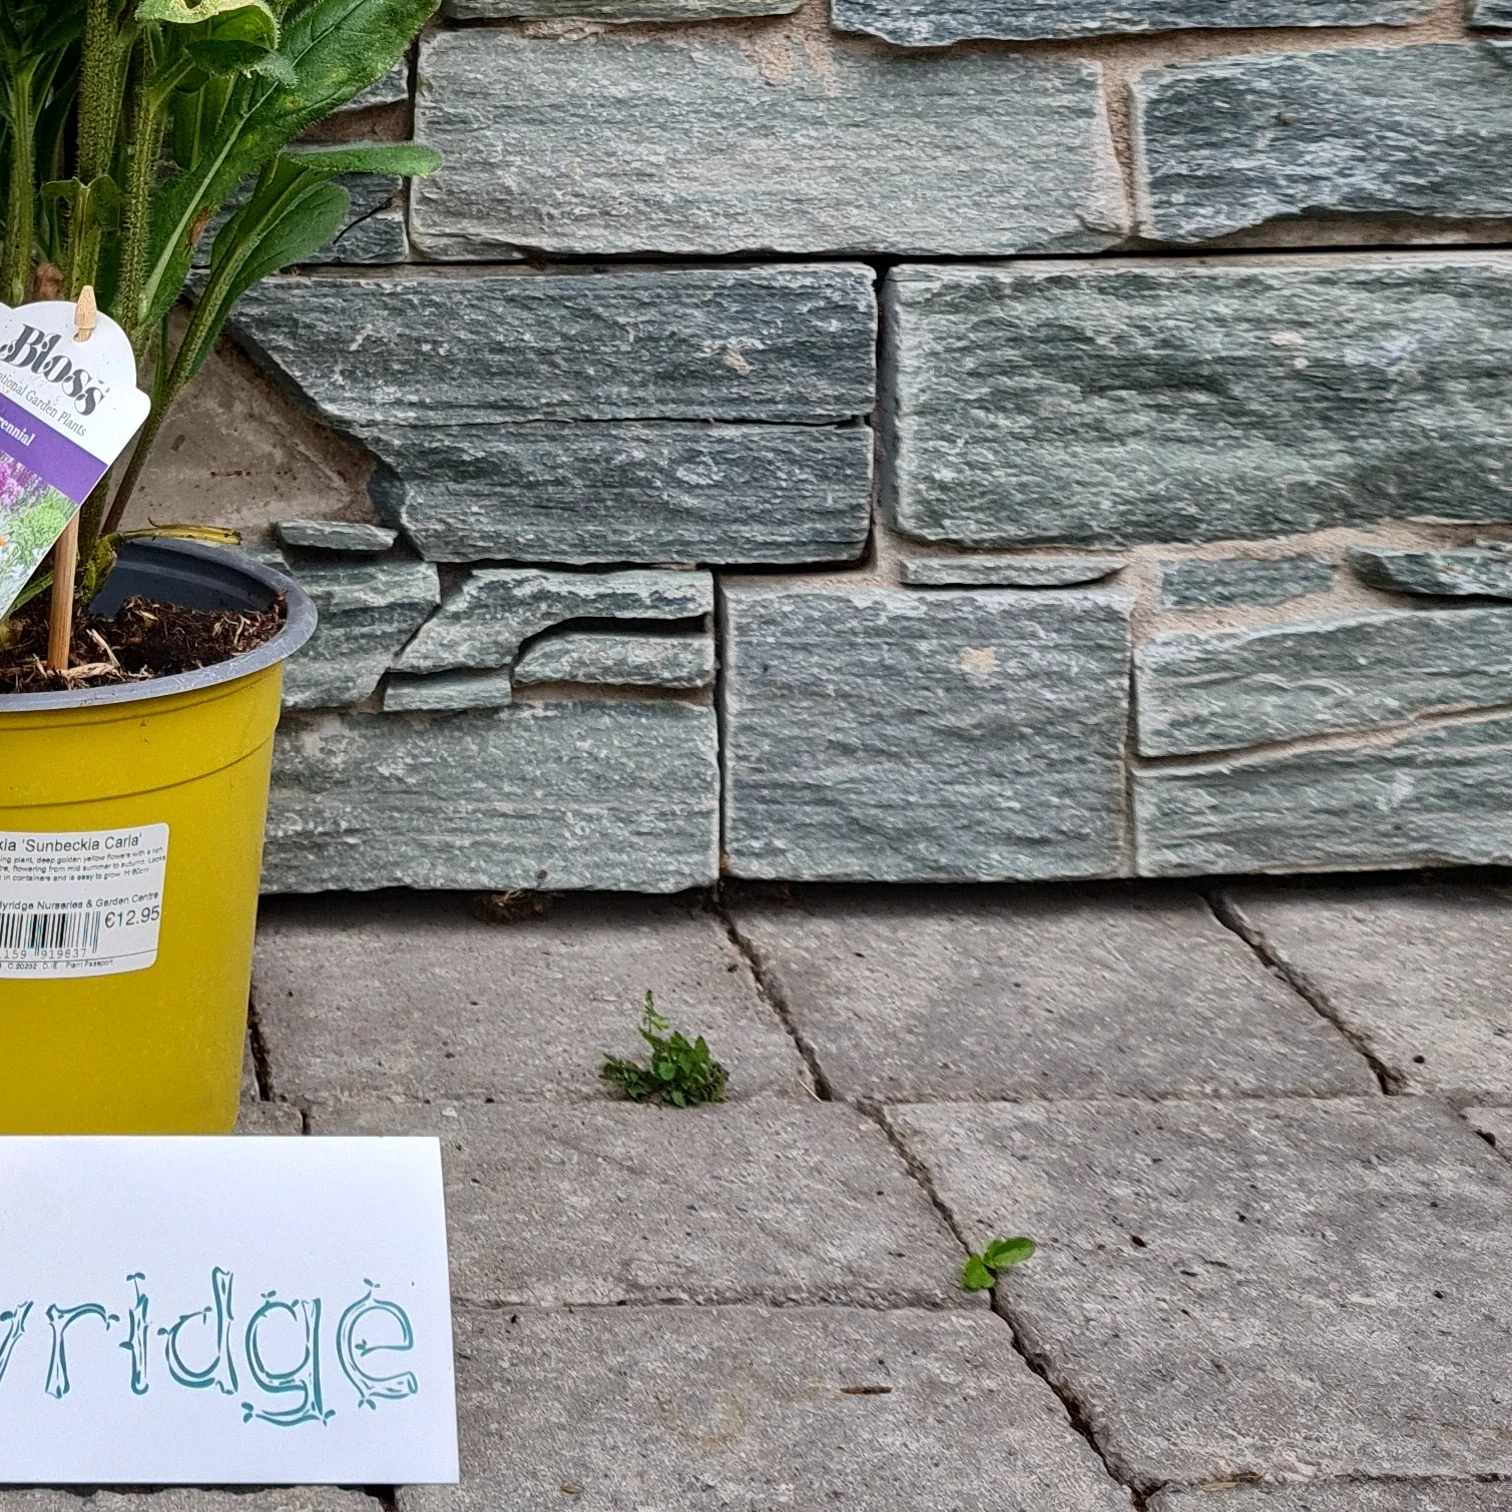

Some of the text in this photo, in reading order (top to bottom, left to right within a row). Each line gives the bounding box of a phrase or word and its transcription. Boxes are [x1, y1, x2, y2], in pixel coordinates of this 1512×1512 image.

[25, 390, 58, 419] Garden
[58, 410, 87, 437] Plants
[37, 856, 55, 865] deep
[57, 856, 82, 865] golden
[37, 900, 83, 911] Nurseries
[86, 900, 93, 908] &
[95, 897, 129, 908] Garden
[131, 892, 159, 904] Centre
[104, 905, 160, 929] €12.95
[41, 949, 87, 959] 919837
